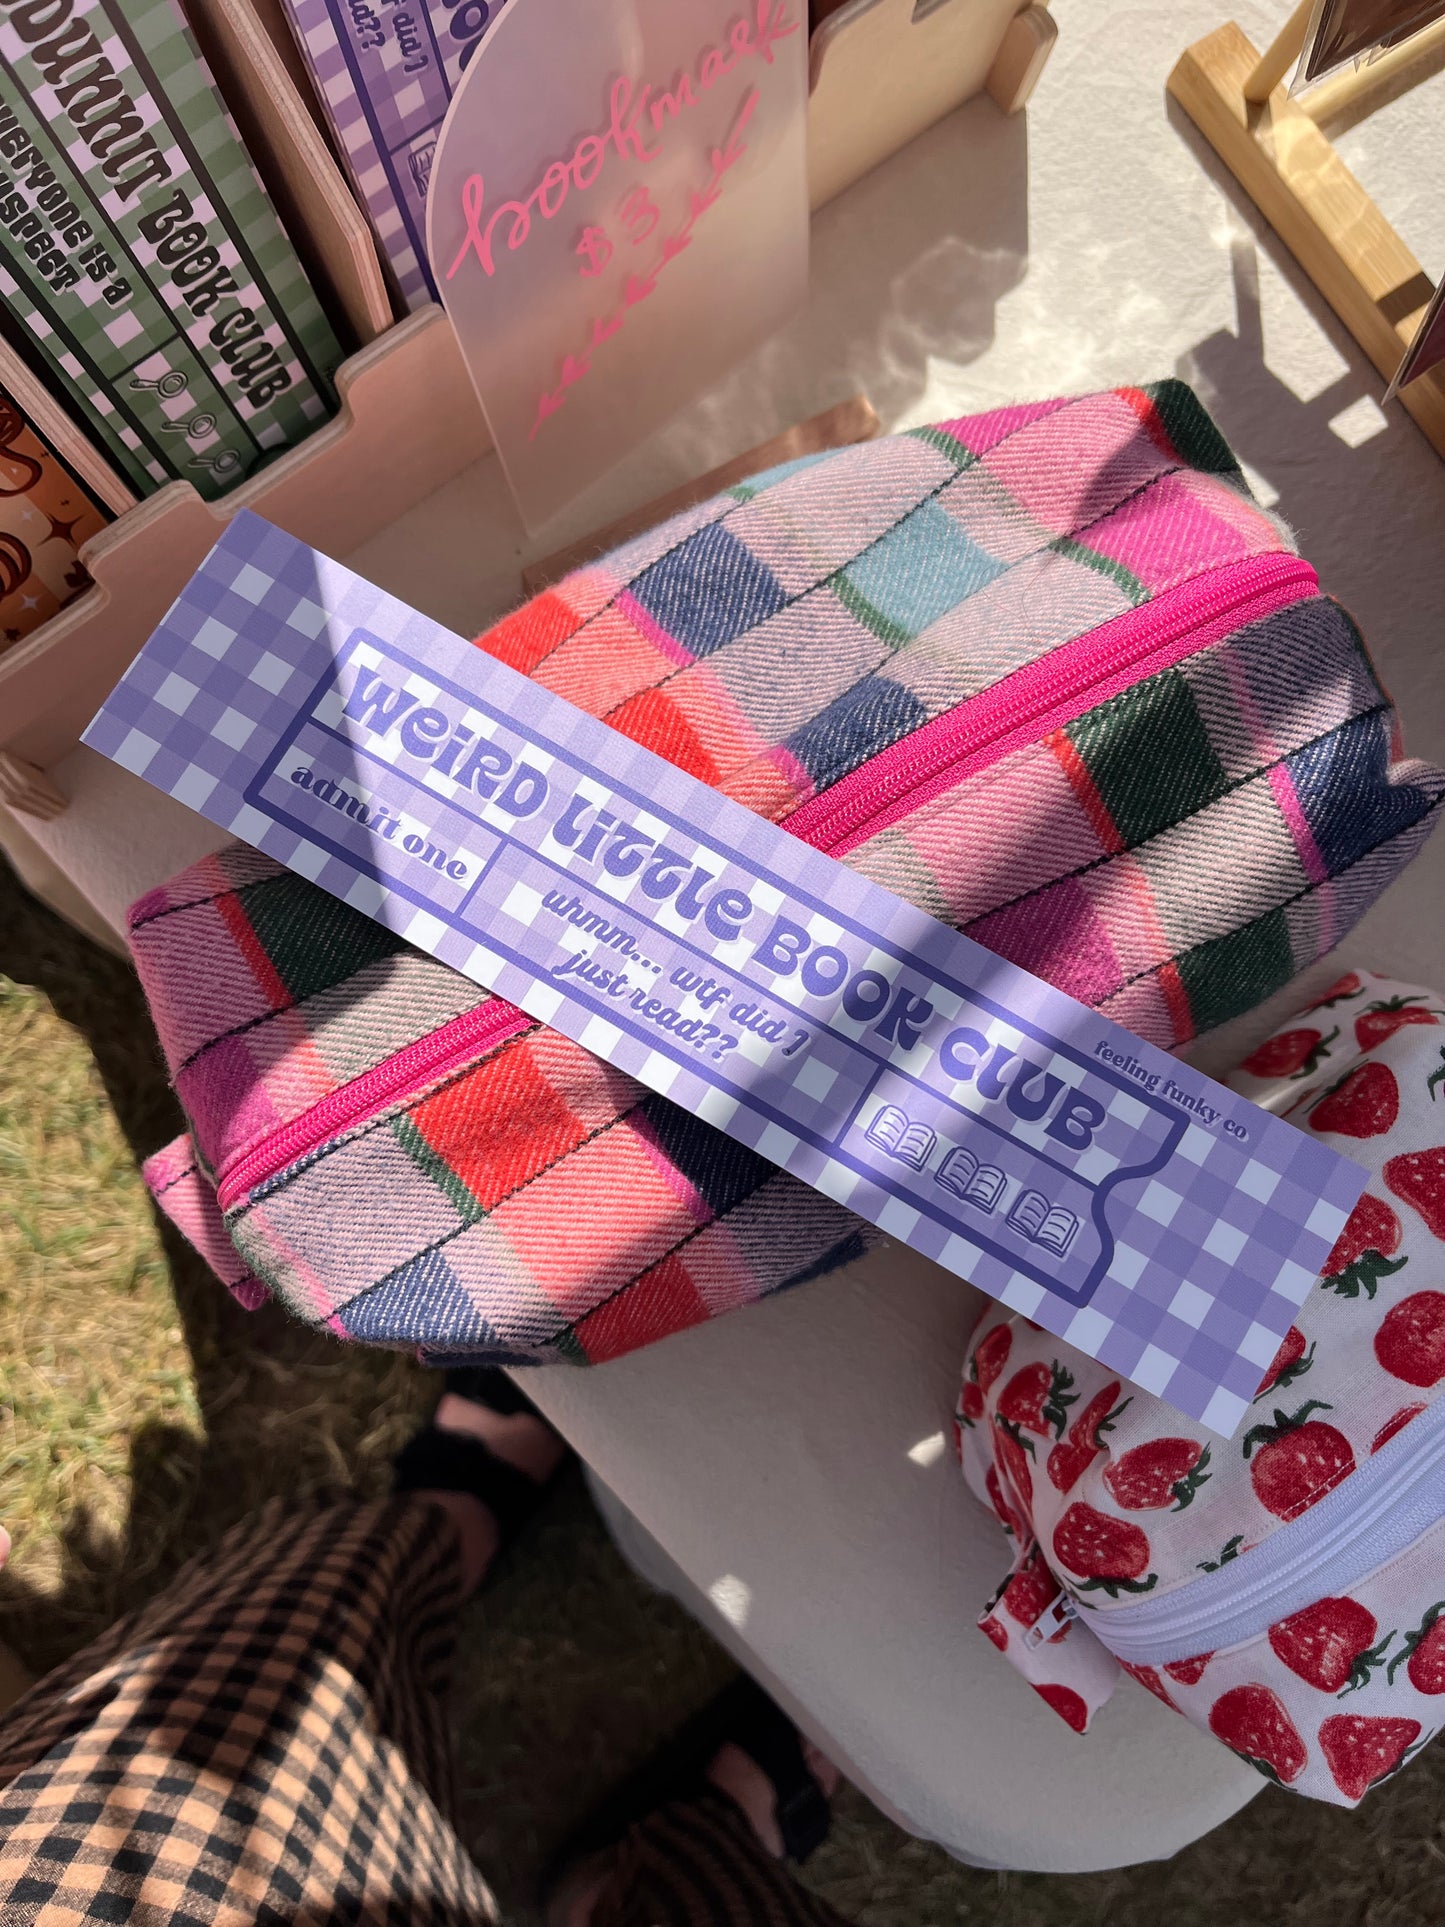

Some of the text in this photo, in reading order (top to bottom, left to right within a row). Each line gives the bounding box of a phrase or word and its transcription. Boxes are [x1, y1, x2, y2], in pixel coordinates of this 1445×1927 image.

[392, 12, 422, 57] did
[0, 92, 94, 249] veryone
[0, 0, 293, 411] DUNNIT BOOK CLUB
[0, 165, 82, 297] uspect
[290, 766, 469, 880] admit one
[551, 949, 739, 1060] just read??
[669, 966, 732, 1010] wtf
[728, 1001, 787, 1043] did
[751, 914, 934, 1051] BOOK
[939, 1026, 1106, 1151] CLUB
[1094, 1040, 1248, 1140] feeling funky co
